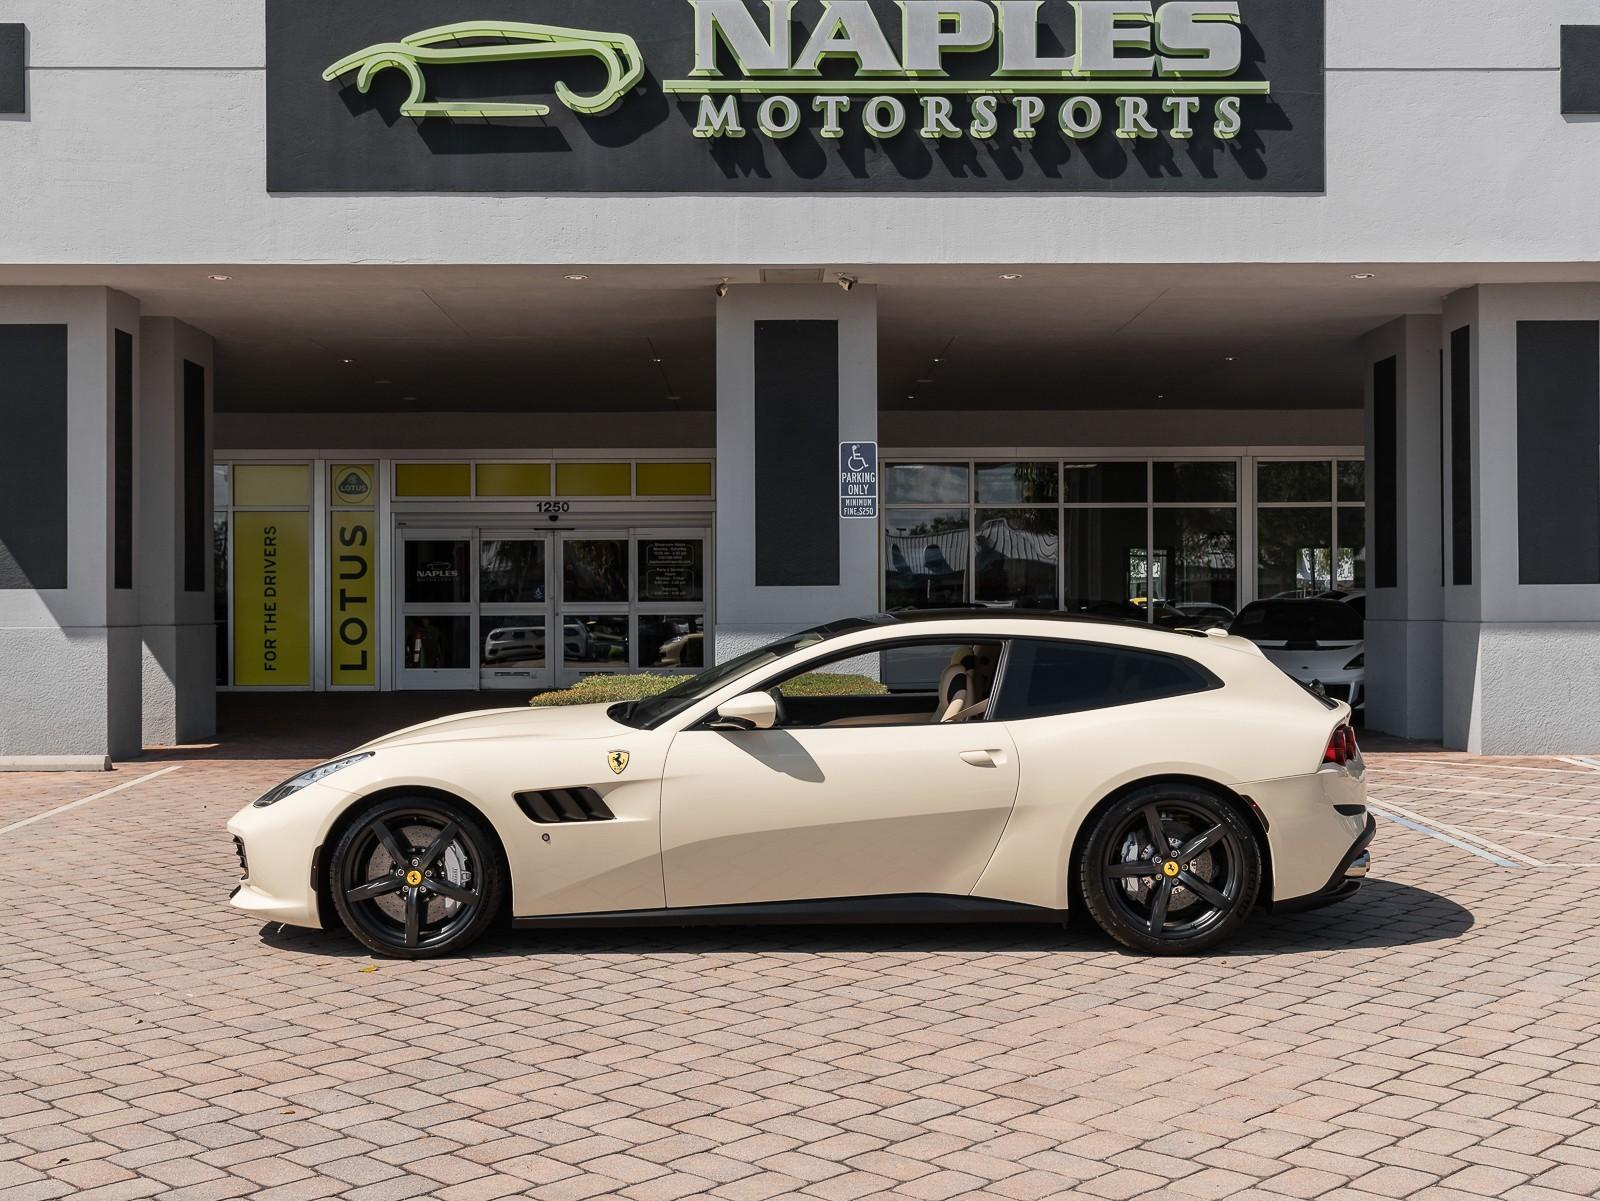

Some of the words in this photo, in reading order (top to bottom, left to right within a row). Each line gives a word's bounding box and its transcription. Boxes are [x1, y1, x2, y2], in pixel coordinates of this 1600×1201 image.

[688, 0, 1242, 77] NAPLES
[692, 95, 1242, 139] MOTORSPORTS
[841, 472, 875, 483] PARKING
[848, 484, 869, 495] ONLY
[536, 502, 570, 513] 1250
[843, 507, 858, 515] FINE
[859, 507, 873, 515] $250
[845, 498, 872, 506] MINIMUM
[263, 525, 277, 598] DRIVERS
[339, 524, 368, 671] LOTUS
[263, 602, 277, 633] THE
[263, 639, 277, 671] FOR
